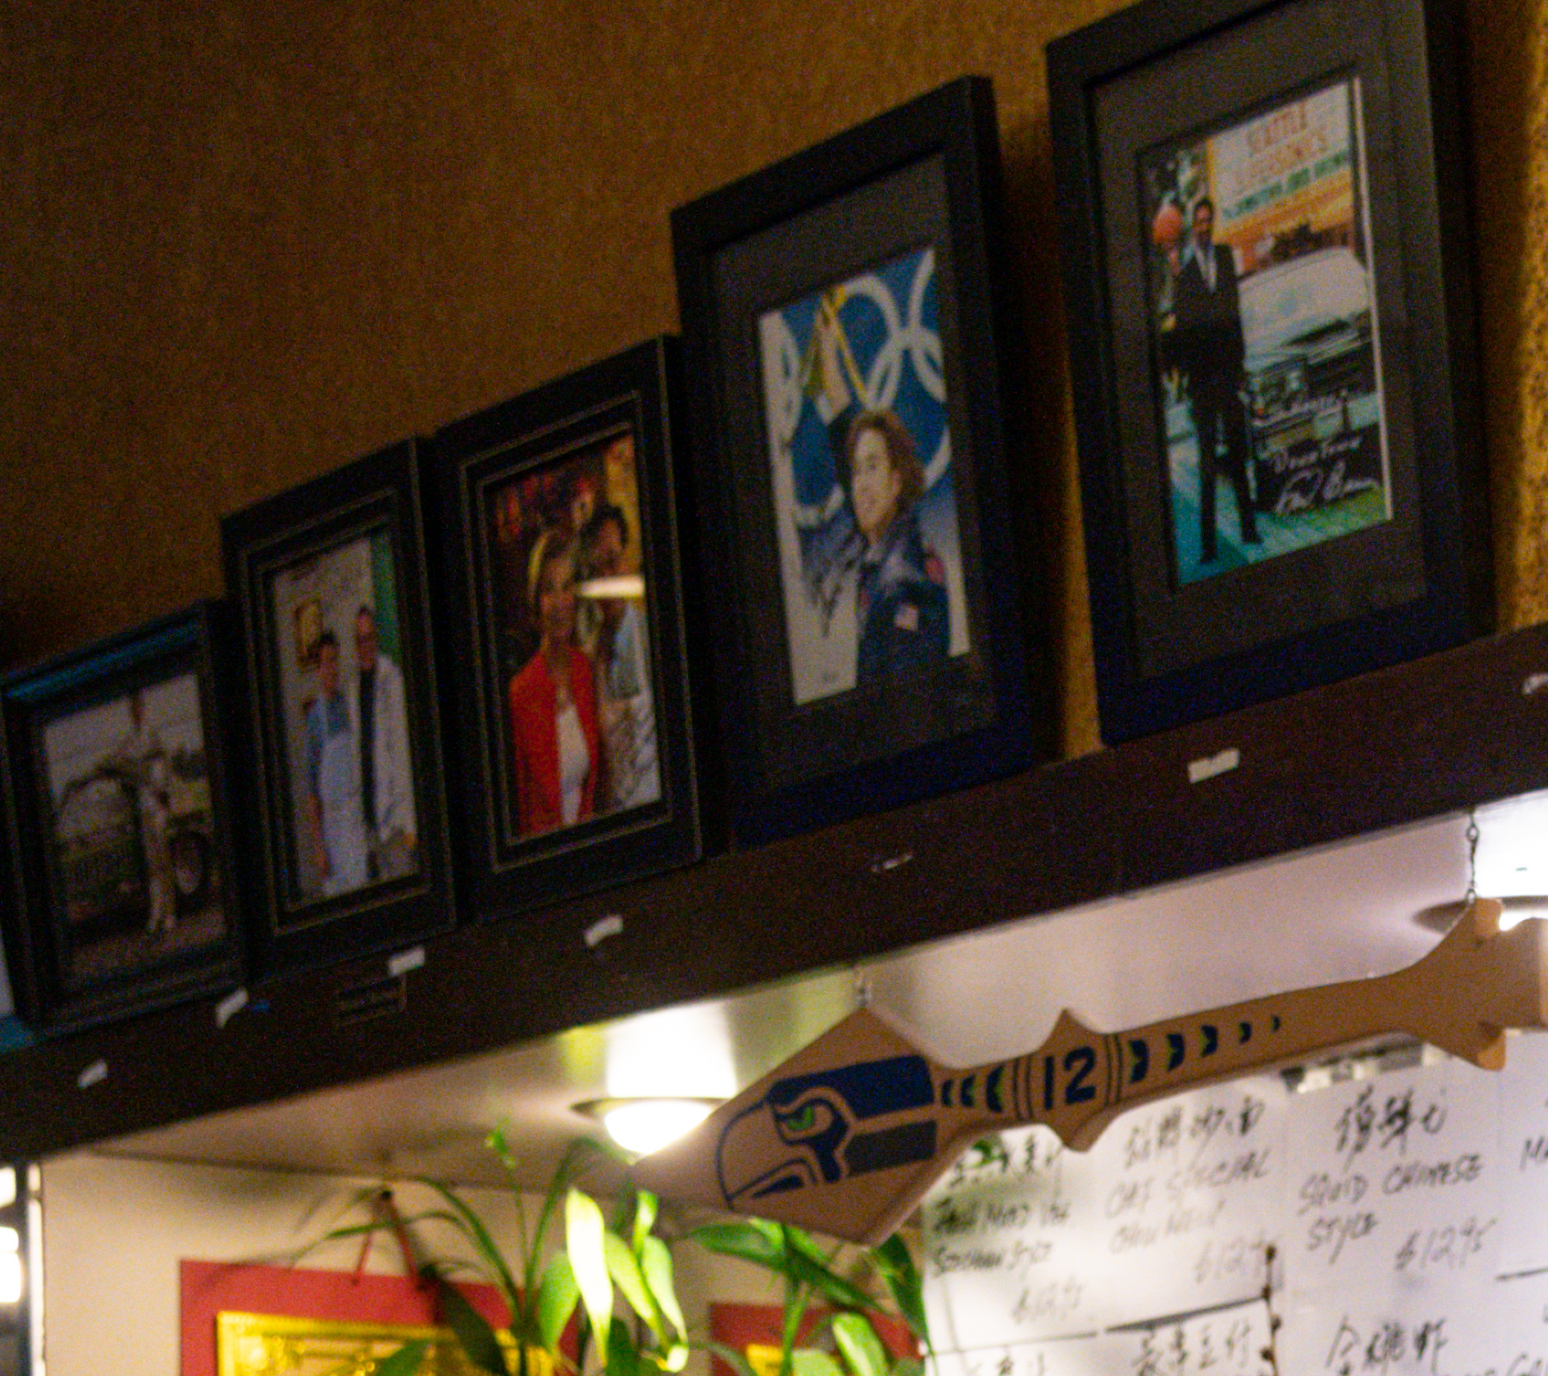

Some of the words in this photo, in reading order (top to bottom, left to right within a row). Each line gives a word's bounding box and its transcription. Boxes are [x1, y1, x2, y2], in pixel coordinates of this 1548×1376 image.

[1042, 1046, 1098, 1110] 12
[1298, 1171, 1370, 1216] SQUID
[1382, 1151, 1484, 1198] CHINESE
